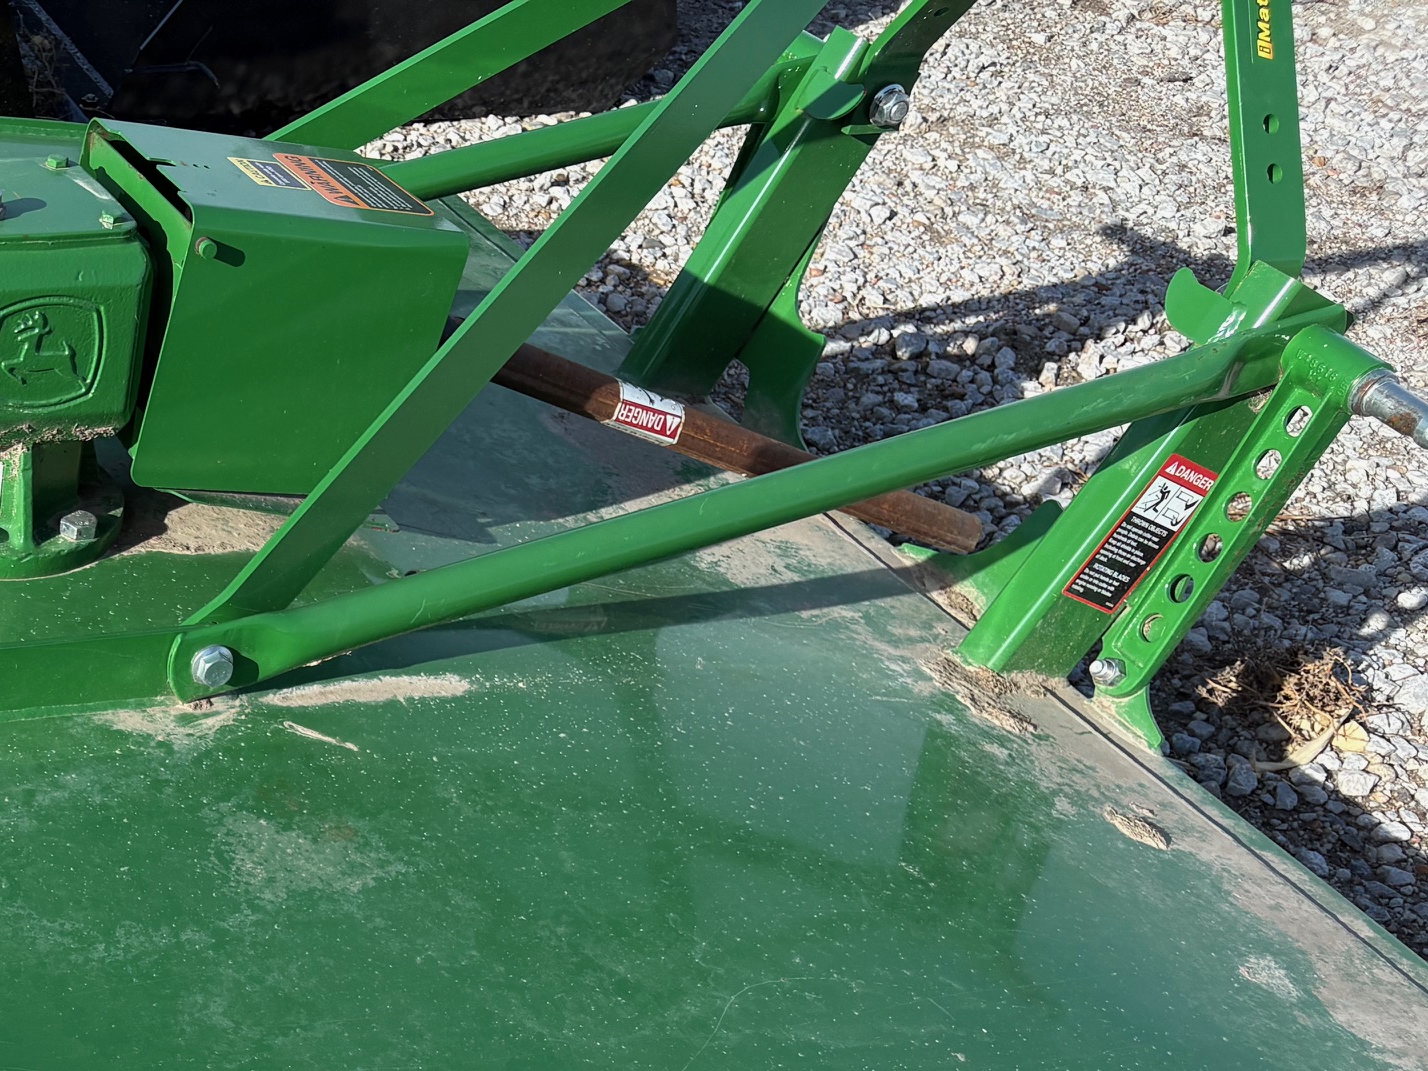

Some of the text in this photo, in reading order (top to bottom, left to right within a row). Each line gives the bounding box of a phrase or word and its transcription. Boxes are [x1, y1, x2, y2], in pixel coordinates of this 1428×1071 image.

[284, 155, 343, 194] WARNING
[617, 403, 664, 431] DANGER
[1175, 465, 1215, 492] DANGER
